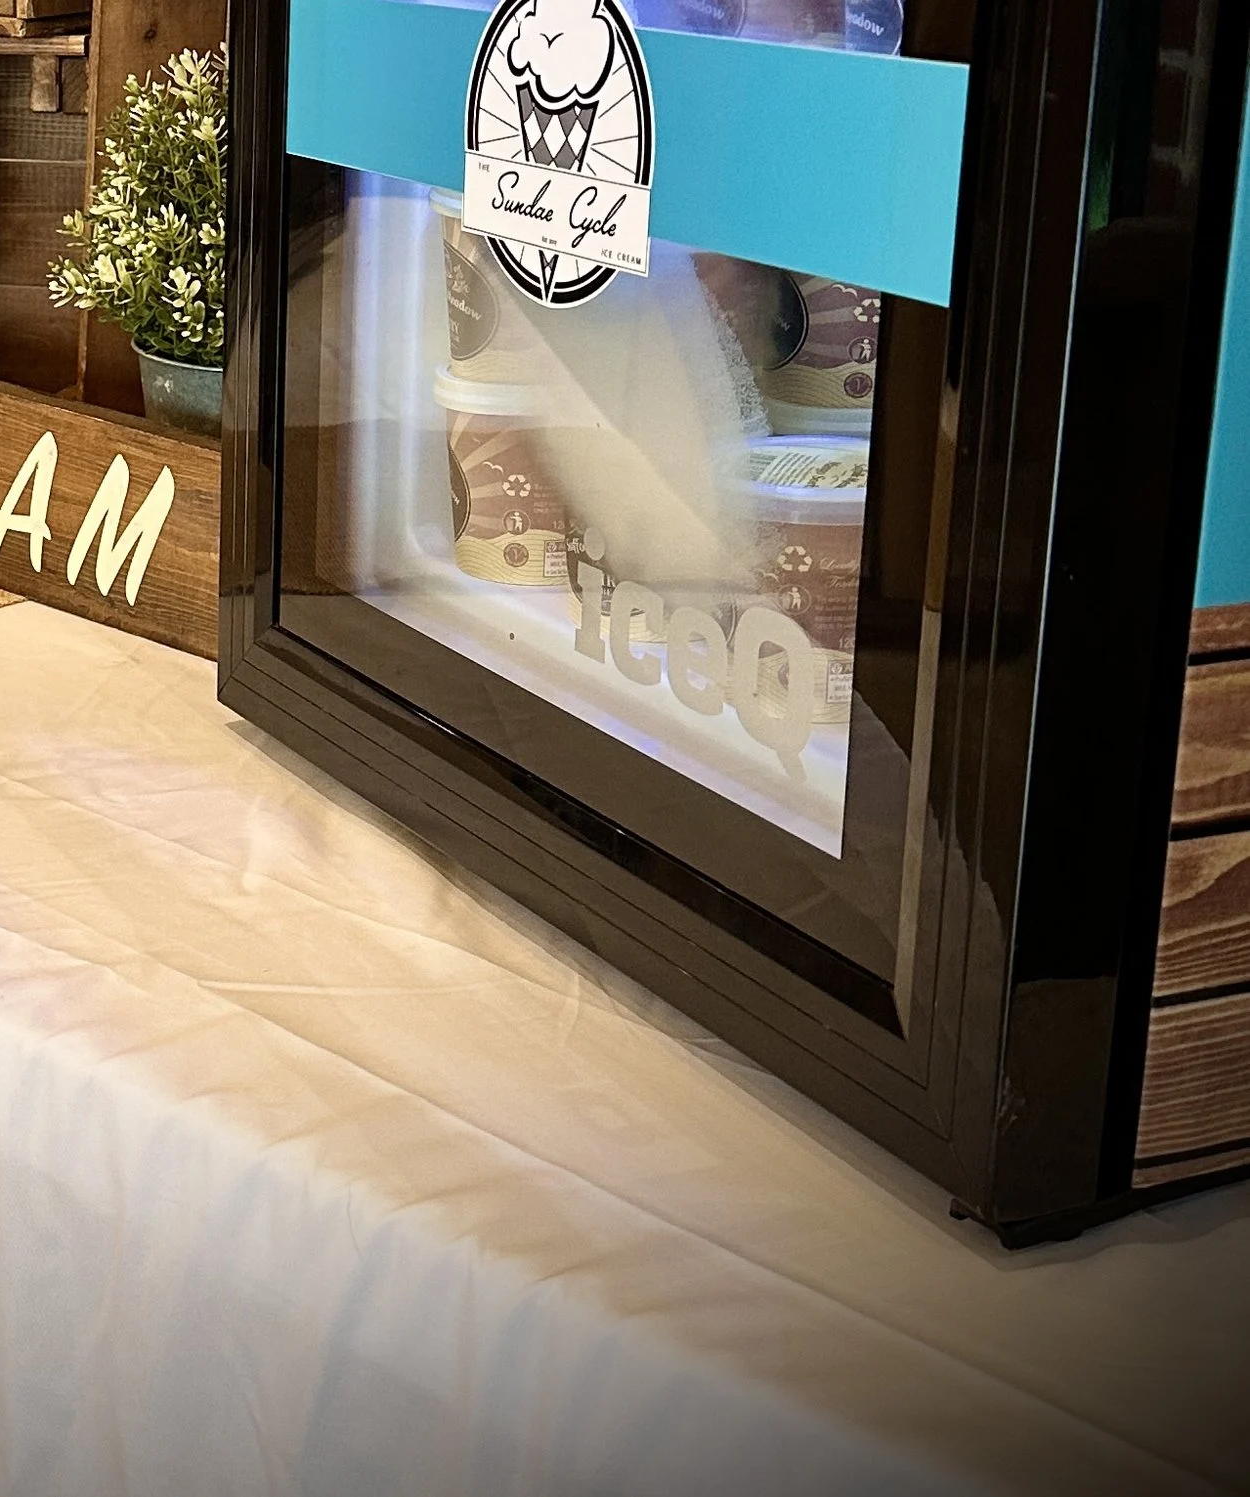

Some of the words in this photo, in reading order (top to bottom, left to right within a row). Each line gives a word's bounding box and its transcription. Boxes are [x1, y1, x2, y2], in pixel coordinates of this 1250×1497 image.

[491, 170, 555, 222] Sundae
[568, 185, 628, 249] Cycle
[616, 252, 642, 266] CREAM
[573, 528, 815, 783] iceQ
